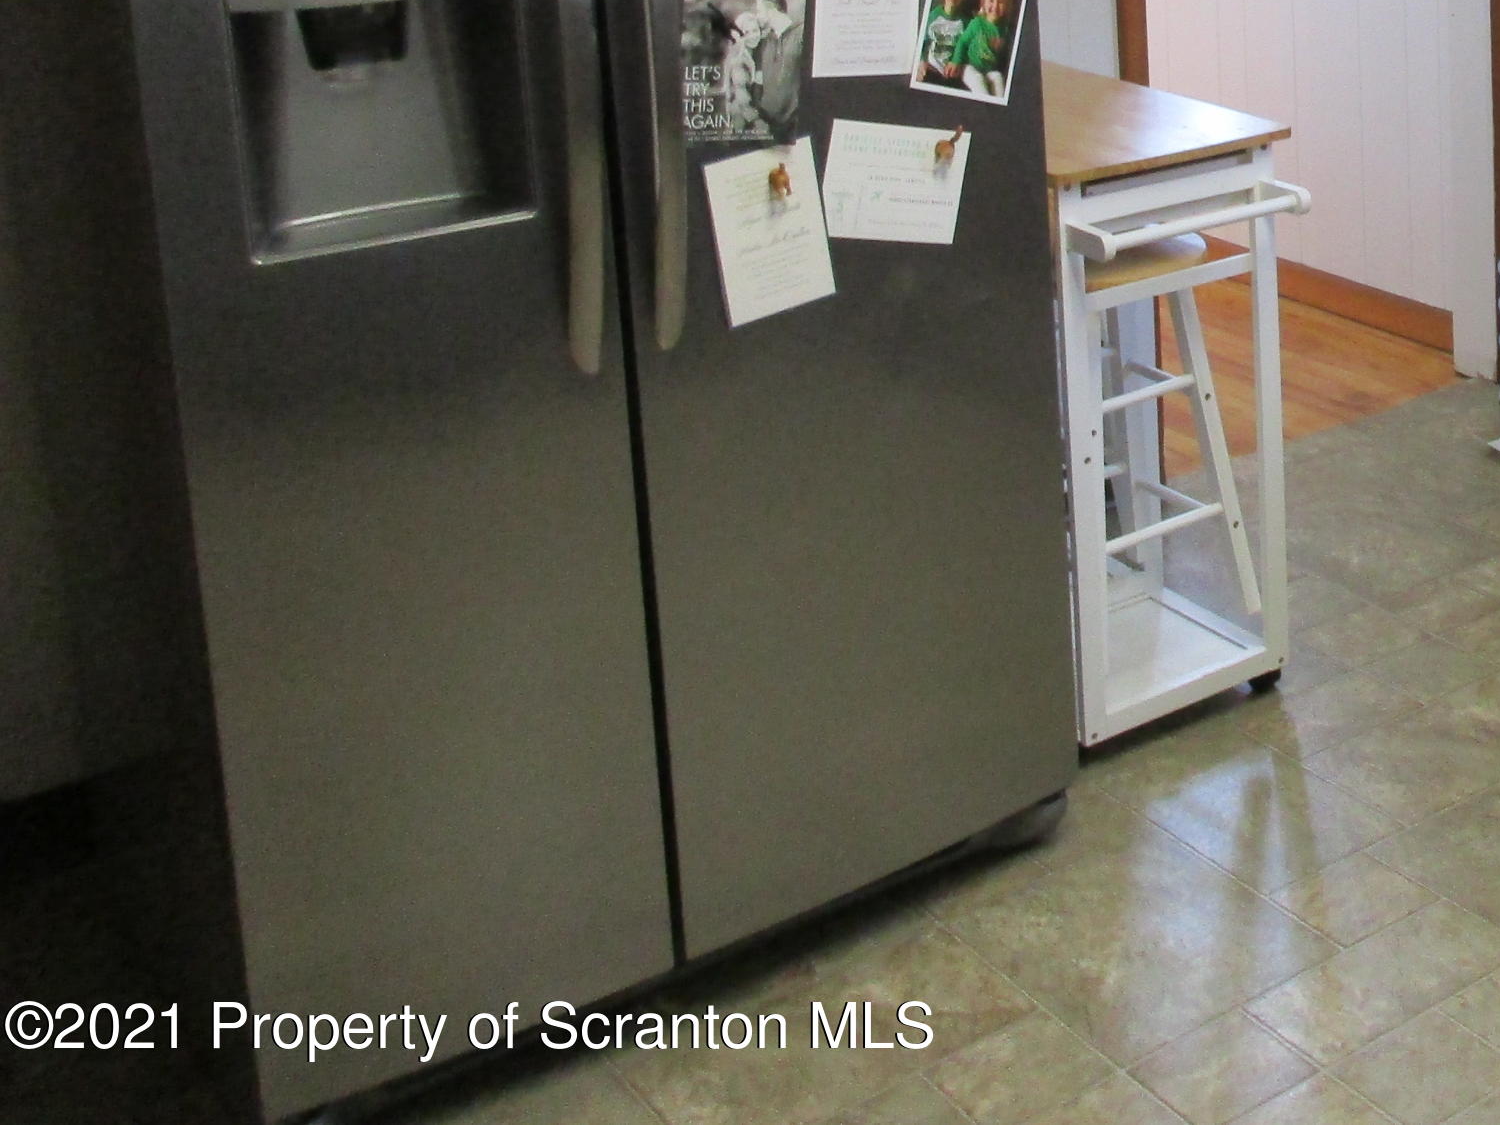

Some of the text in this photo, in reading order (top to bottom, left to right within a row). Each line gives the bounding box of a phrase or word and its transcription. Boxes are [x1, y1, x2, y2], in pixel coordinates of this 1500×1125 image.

[685, 66, 721, 81] LET'S
[683, 82, 710, 97] TRY
[683, 98, 714, 113] THIS
[683, 114, 734, 129] AGAIN.
